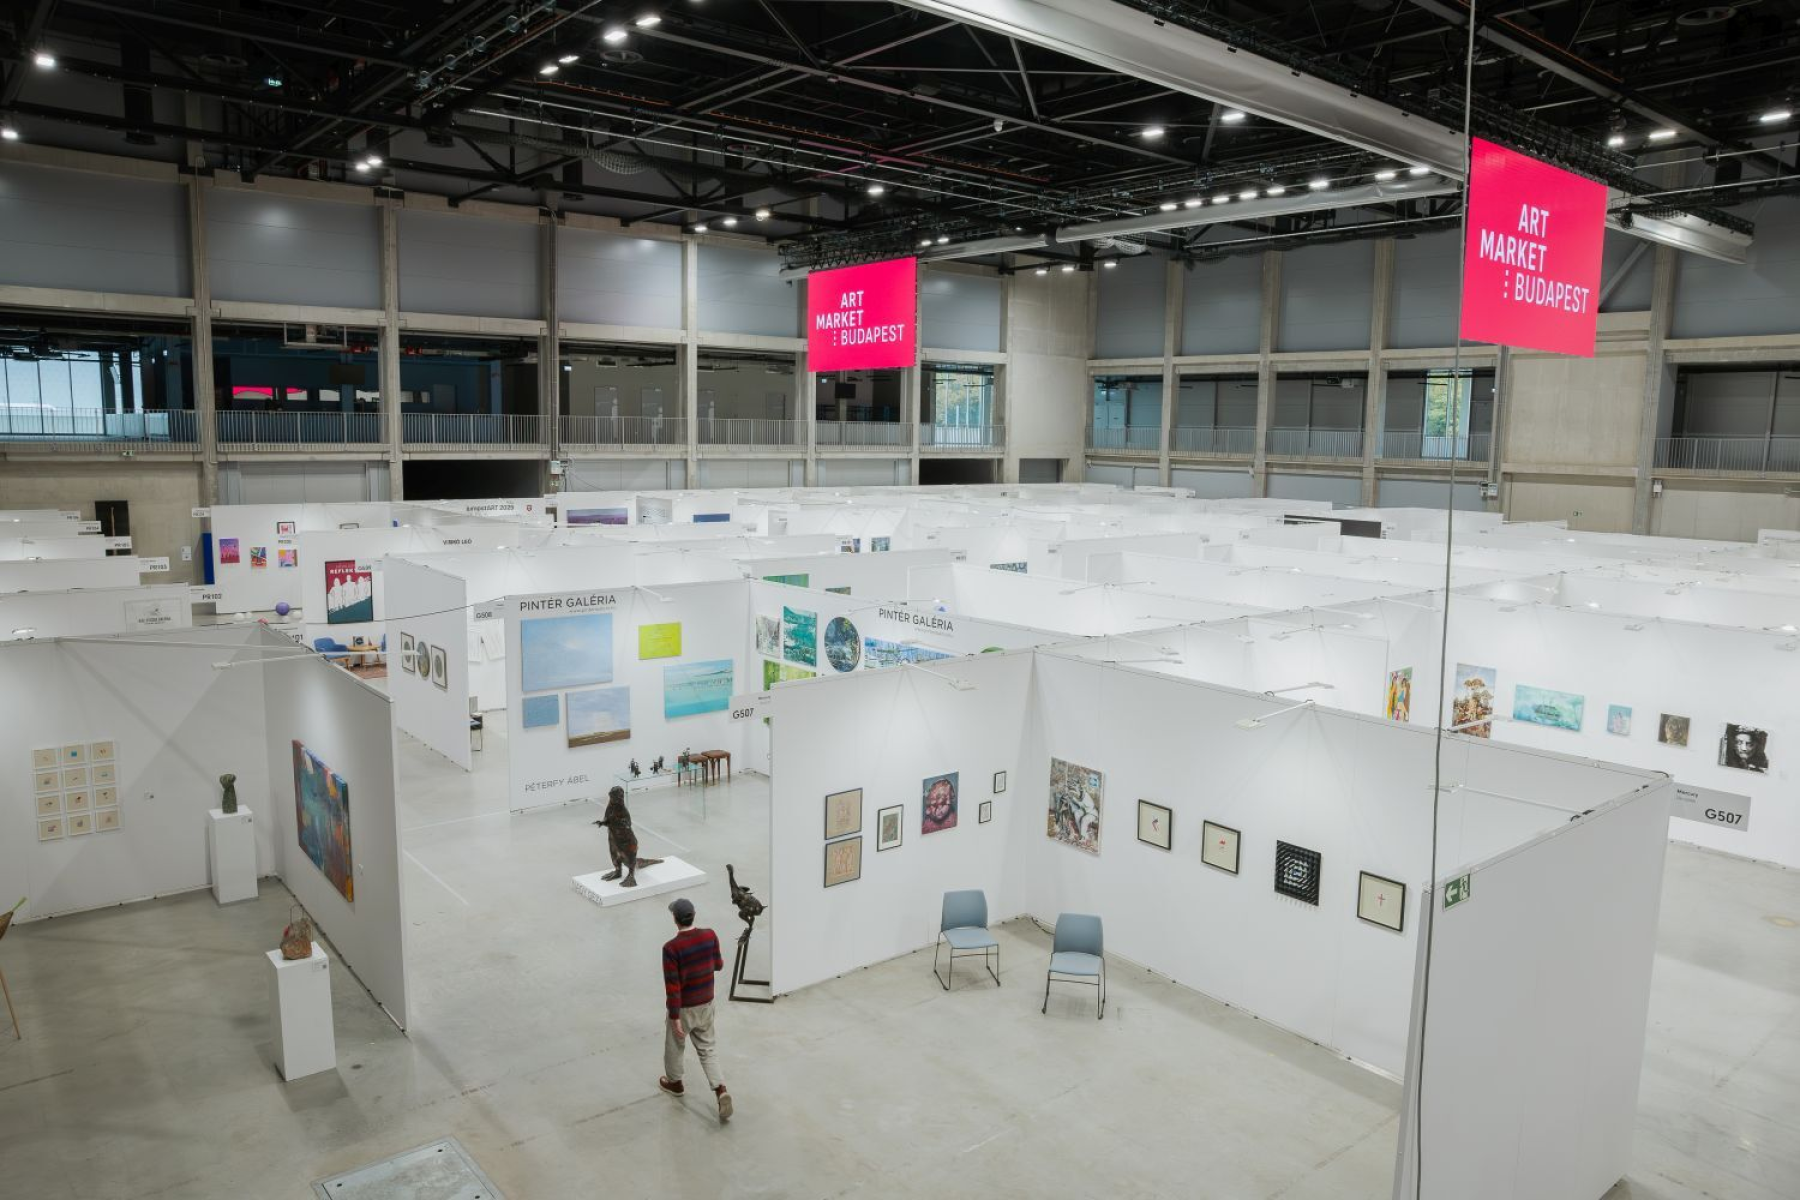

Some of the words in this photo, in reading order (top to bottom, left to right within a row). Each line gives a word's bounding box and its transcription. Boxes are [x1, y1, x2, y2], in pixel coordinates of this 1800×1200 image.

[1517, 203, 1550, 239] ART
[1479, 228, 1548, 273] MARKET
[840, 290, 865, 309] ART
[1514, 272, 1590, 314] BUDAPEST
[815, 309, 864, 330] MARKET
[840, 324, 905, 346] BUDAPEST
[520, 597, 563, 612] PINTÉR
[566, 593, 617, 608] GALÉRIA
[878, 607, 911, 624] PINTÉR
[912, 614, 954, 632] GALÉRIA
[732, 707, 755, 720] G507
[1704, 807, 1743, 825] G507
